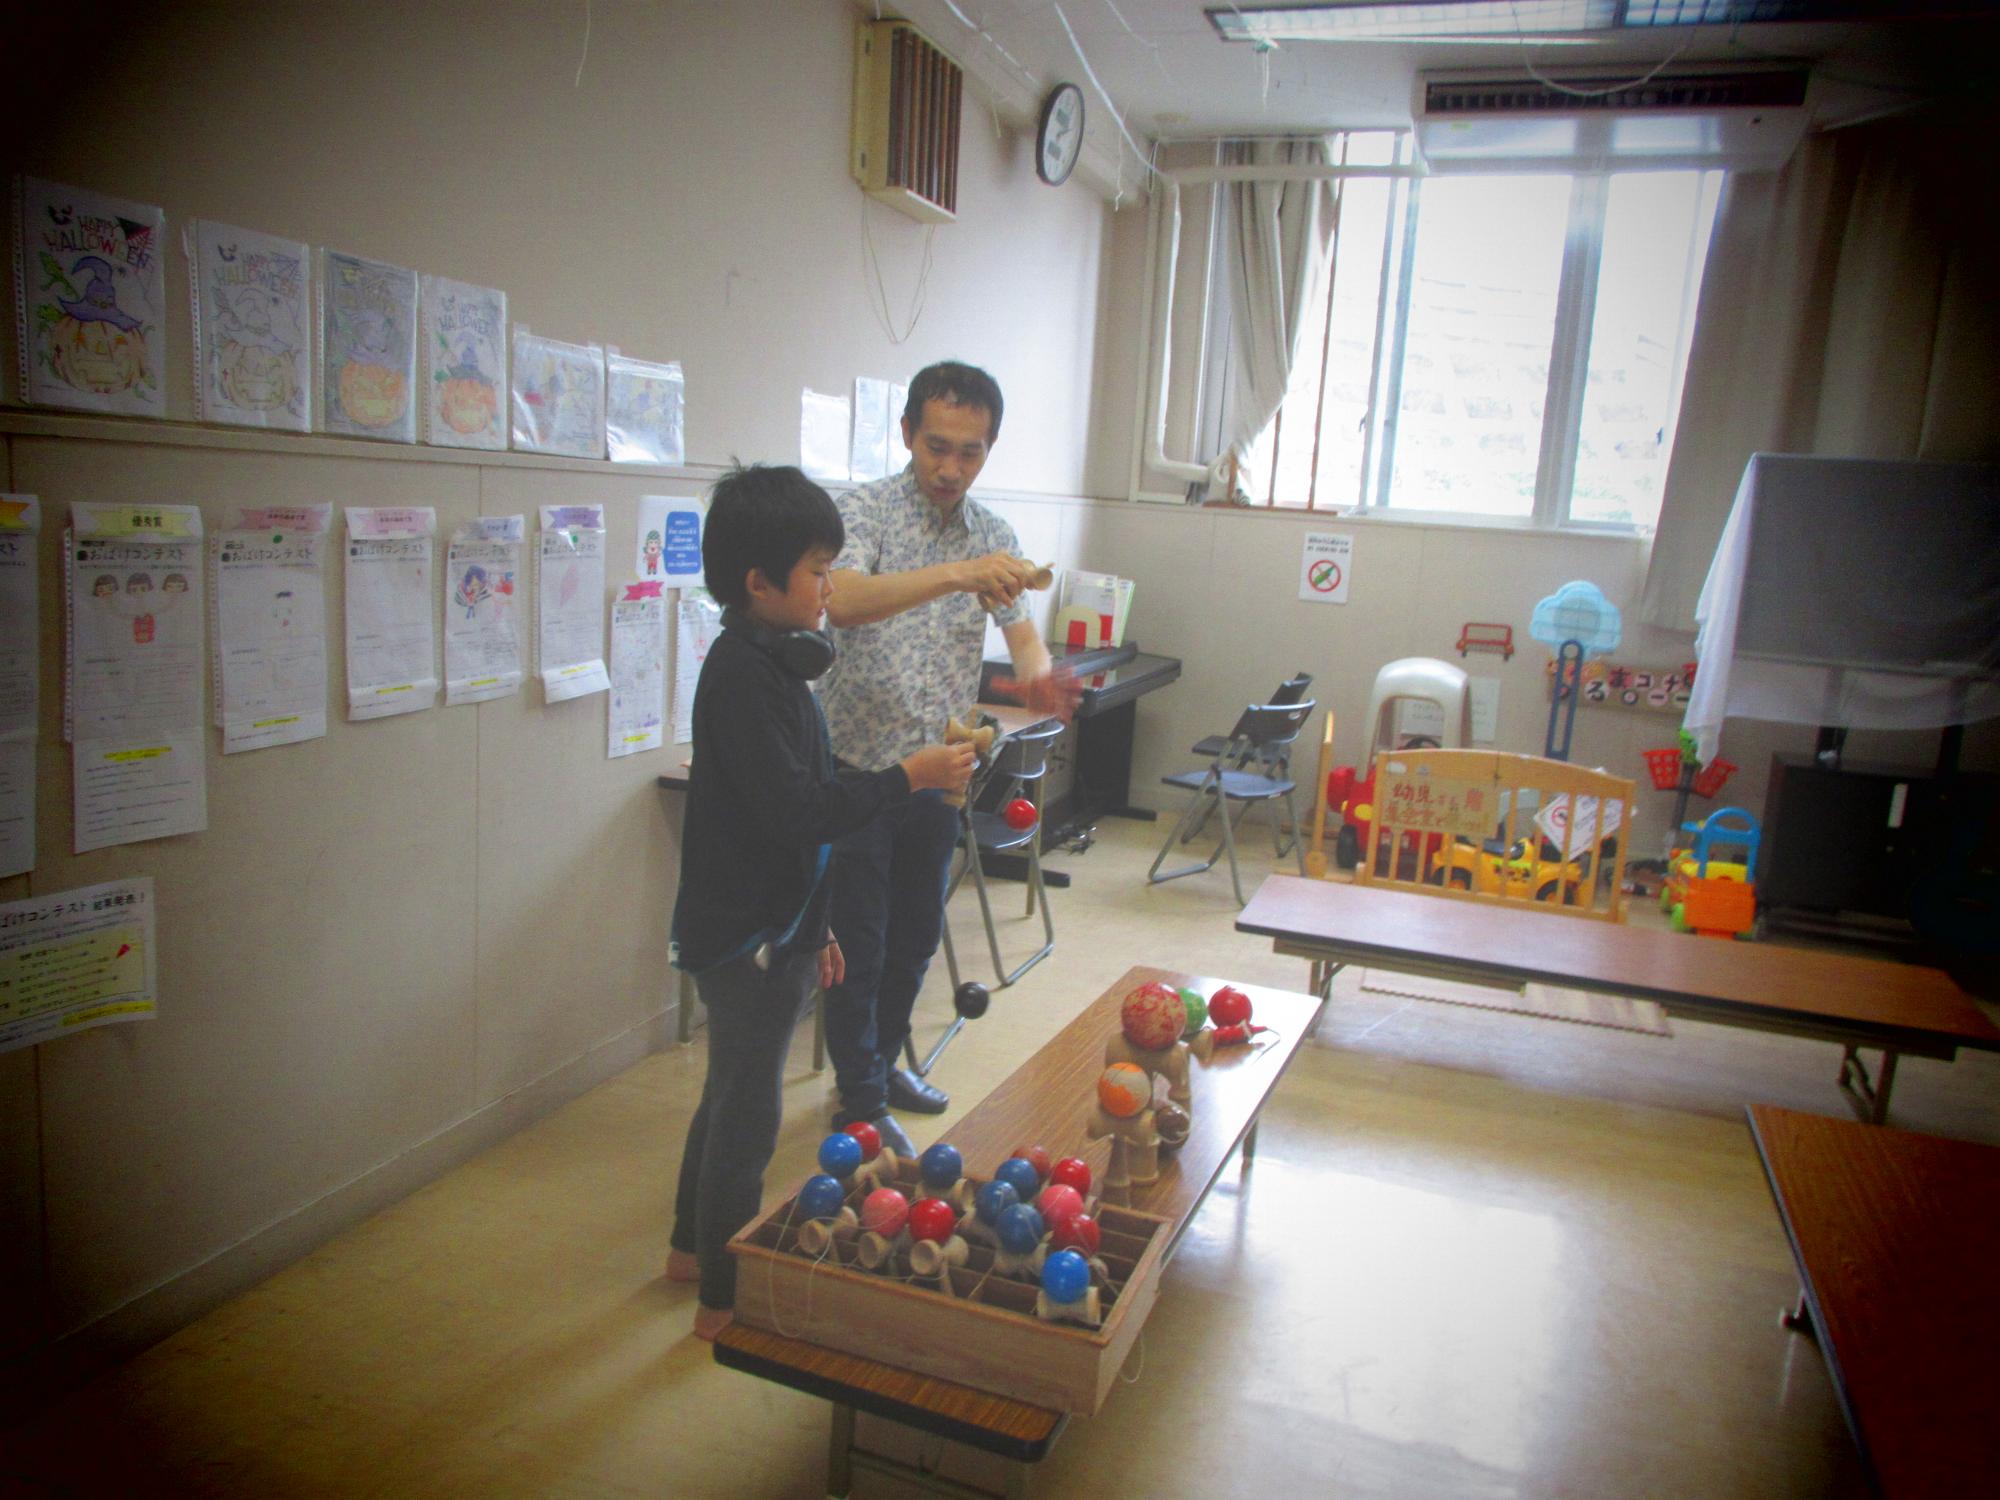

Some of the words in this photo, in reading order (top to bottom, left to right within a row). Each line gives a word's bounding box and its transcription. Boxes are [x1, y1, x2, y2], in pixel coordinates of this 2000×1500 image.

[89, 546, 185, 561] おばけコンテスト
[231, 547, 313, 562] おばけコンテスト
